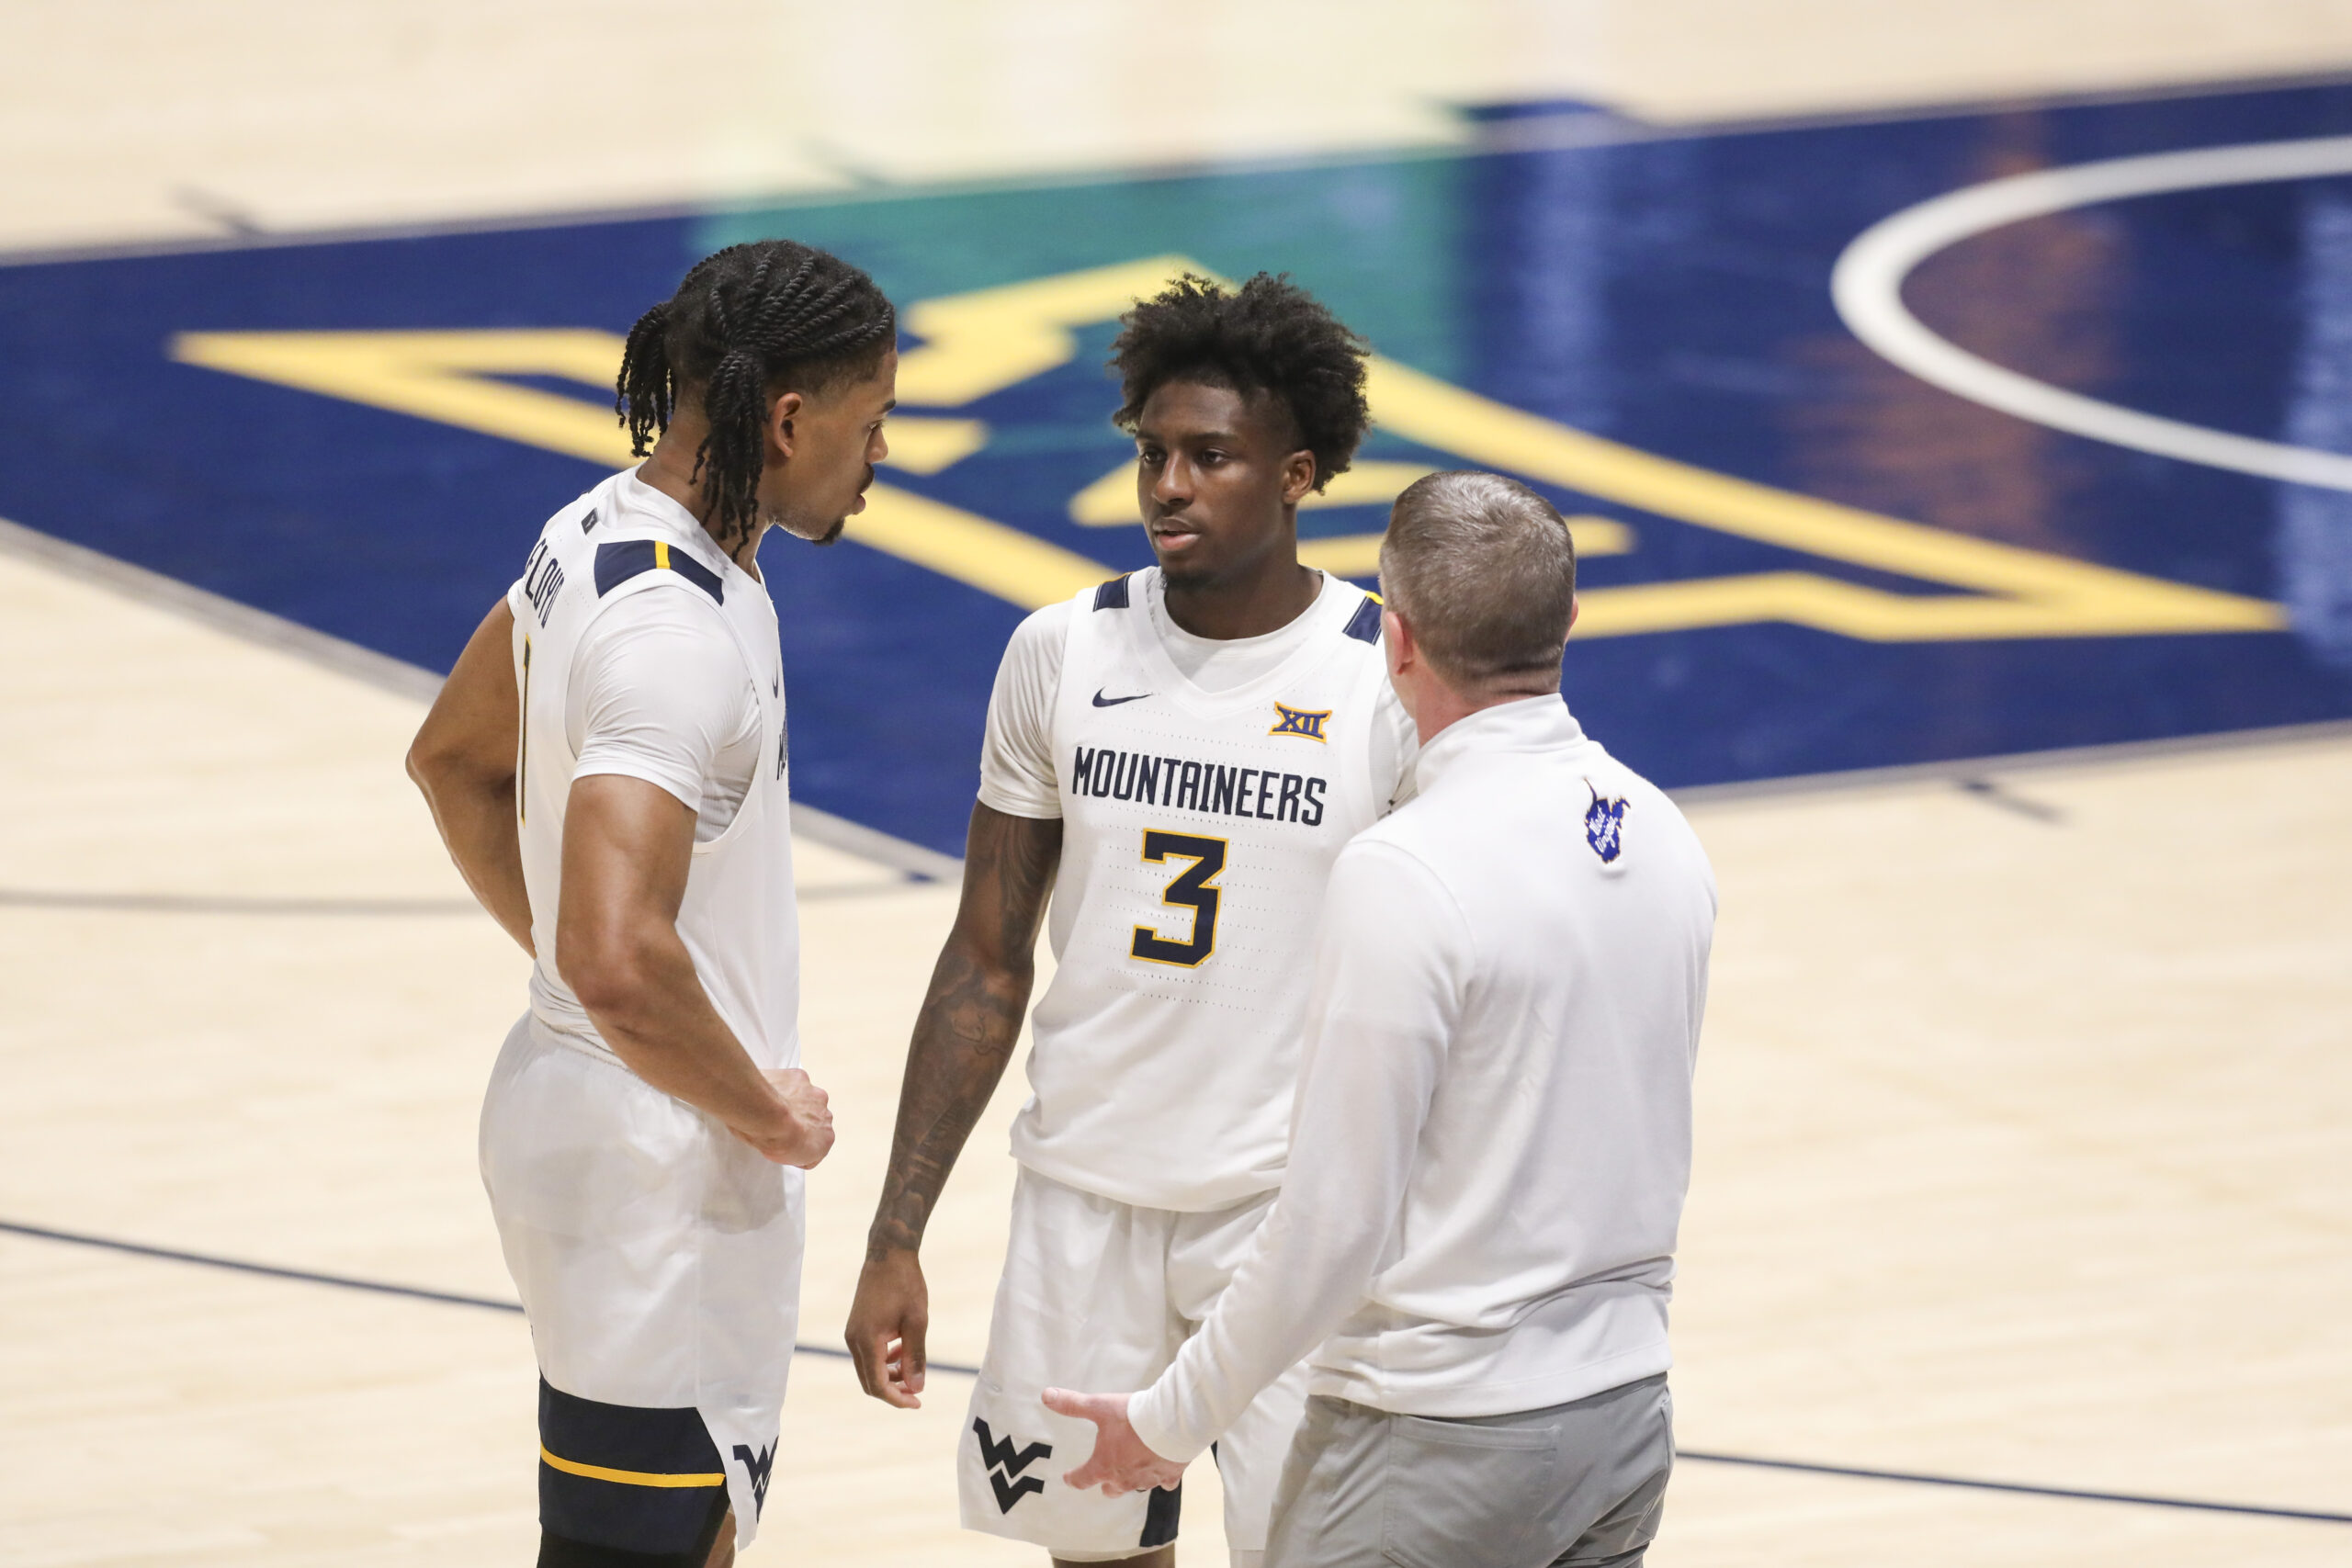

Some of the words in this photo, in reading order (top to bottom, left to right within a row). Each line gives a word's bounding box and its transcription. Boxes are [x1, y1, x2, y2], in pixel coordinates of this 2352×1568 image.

[1269, 701, 1332, 744] XII
[1072, 746, 1327, 827] MOUNTAINEERS
[1130, 828, 1229, 969] 3
